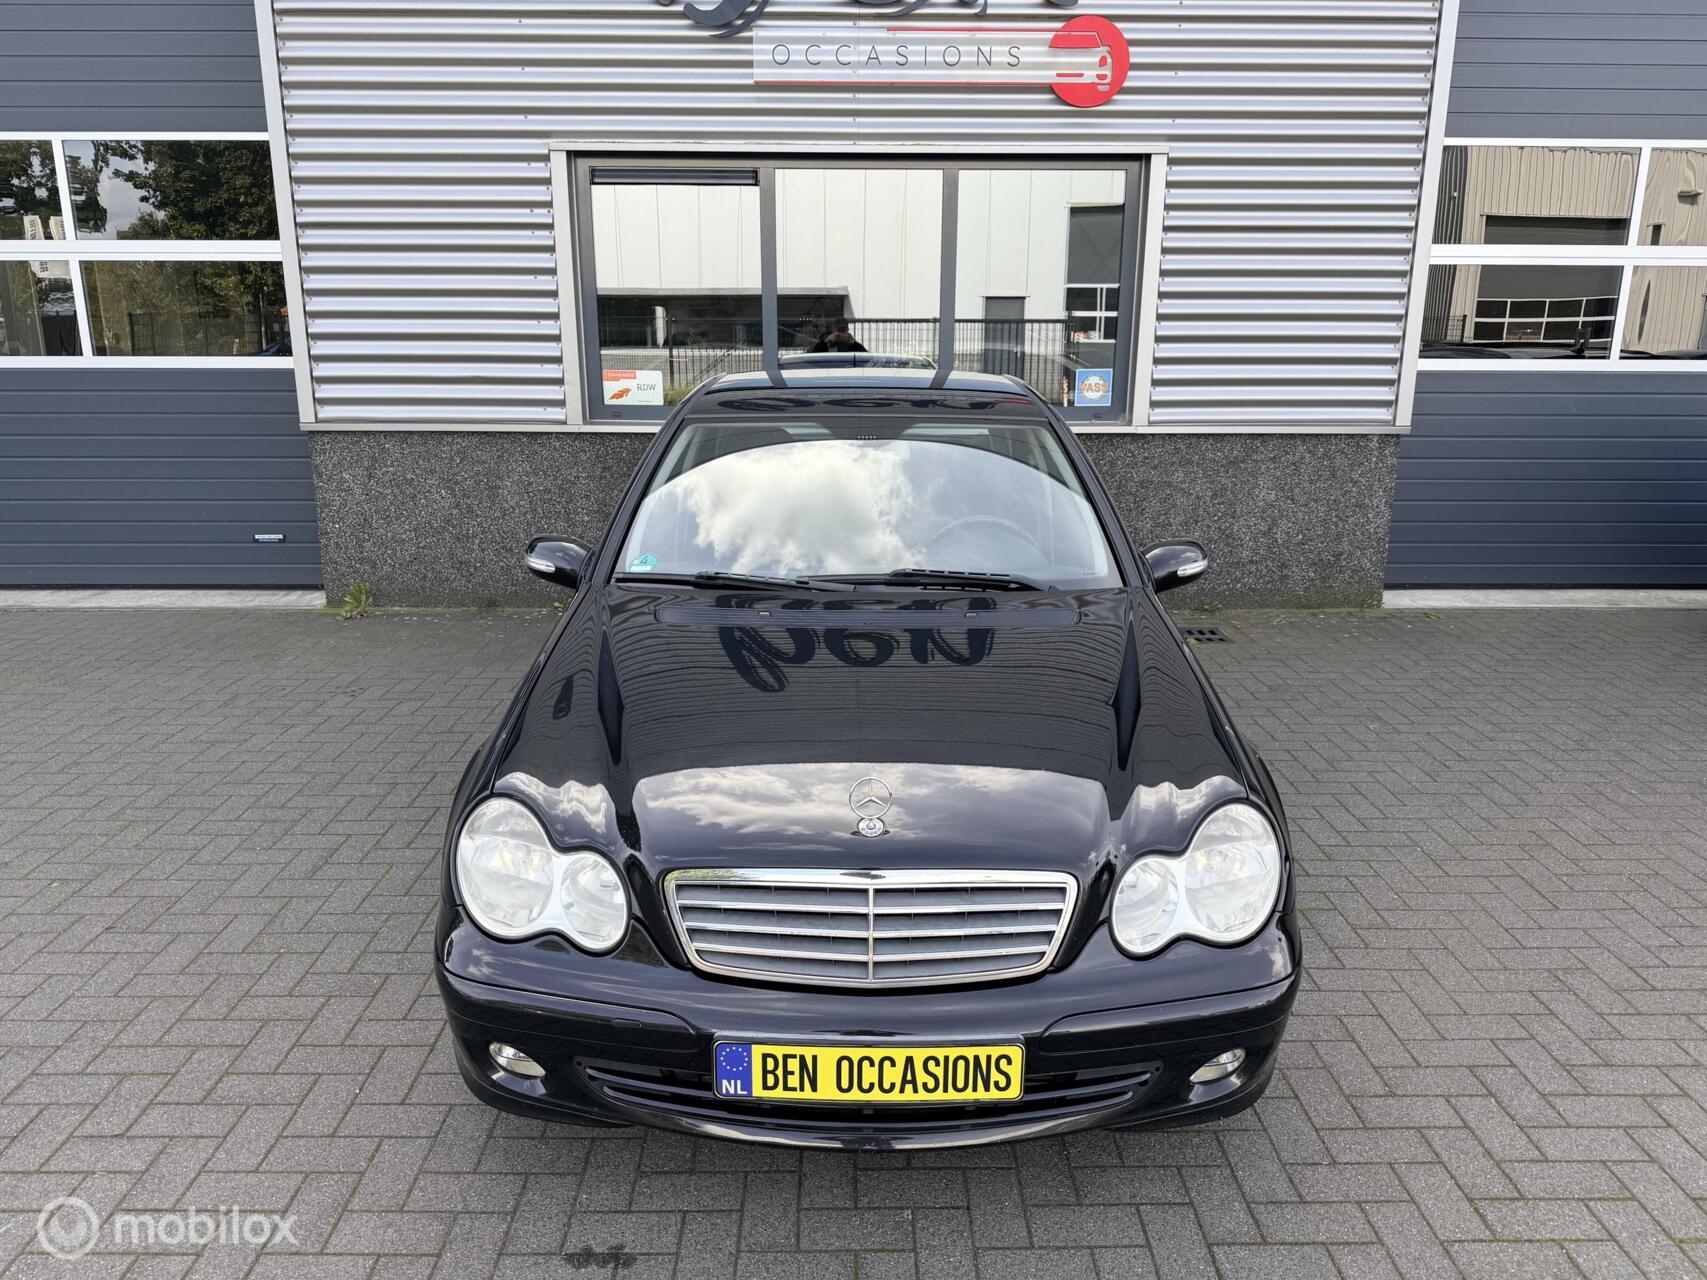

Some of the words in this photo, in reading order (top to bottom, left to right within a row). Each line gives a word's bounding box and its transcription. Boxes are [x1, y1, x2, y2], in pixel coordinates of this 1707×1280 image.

[771, 44, 1021, 67] OCCASIONS
[761, 1052, 818, 1093] BEN
[835, 1053, 1013, 1094] OCCASIONS
[721, 1079, 748, 1095] NL
